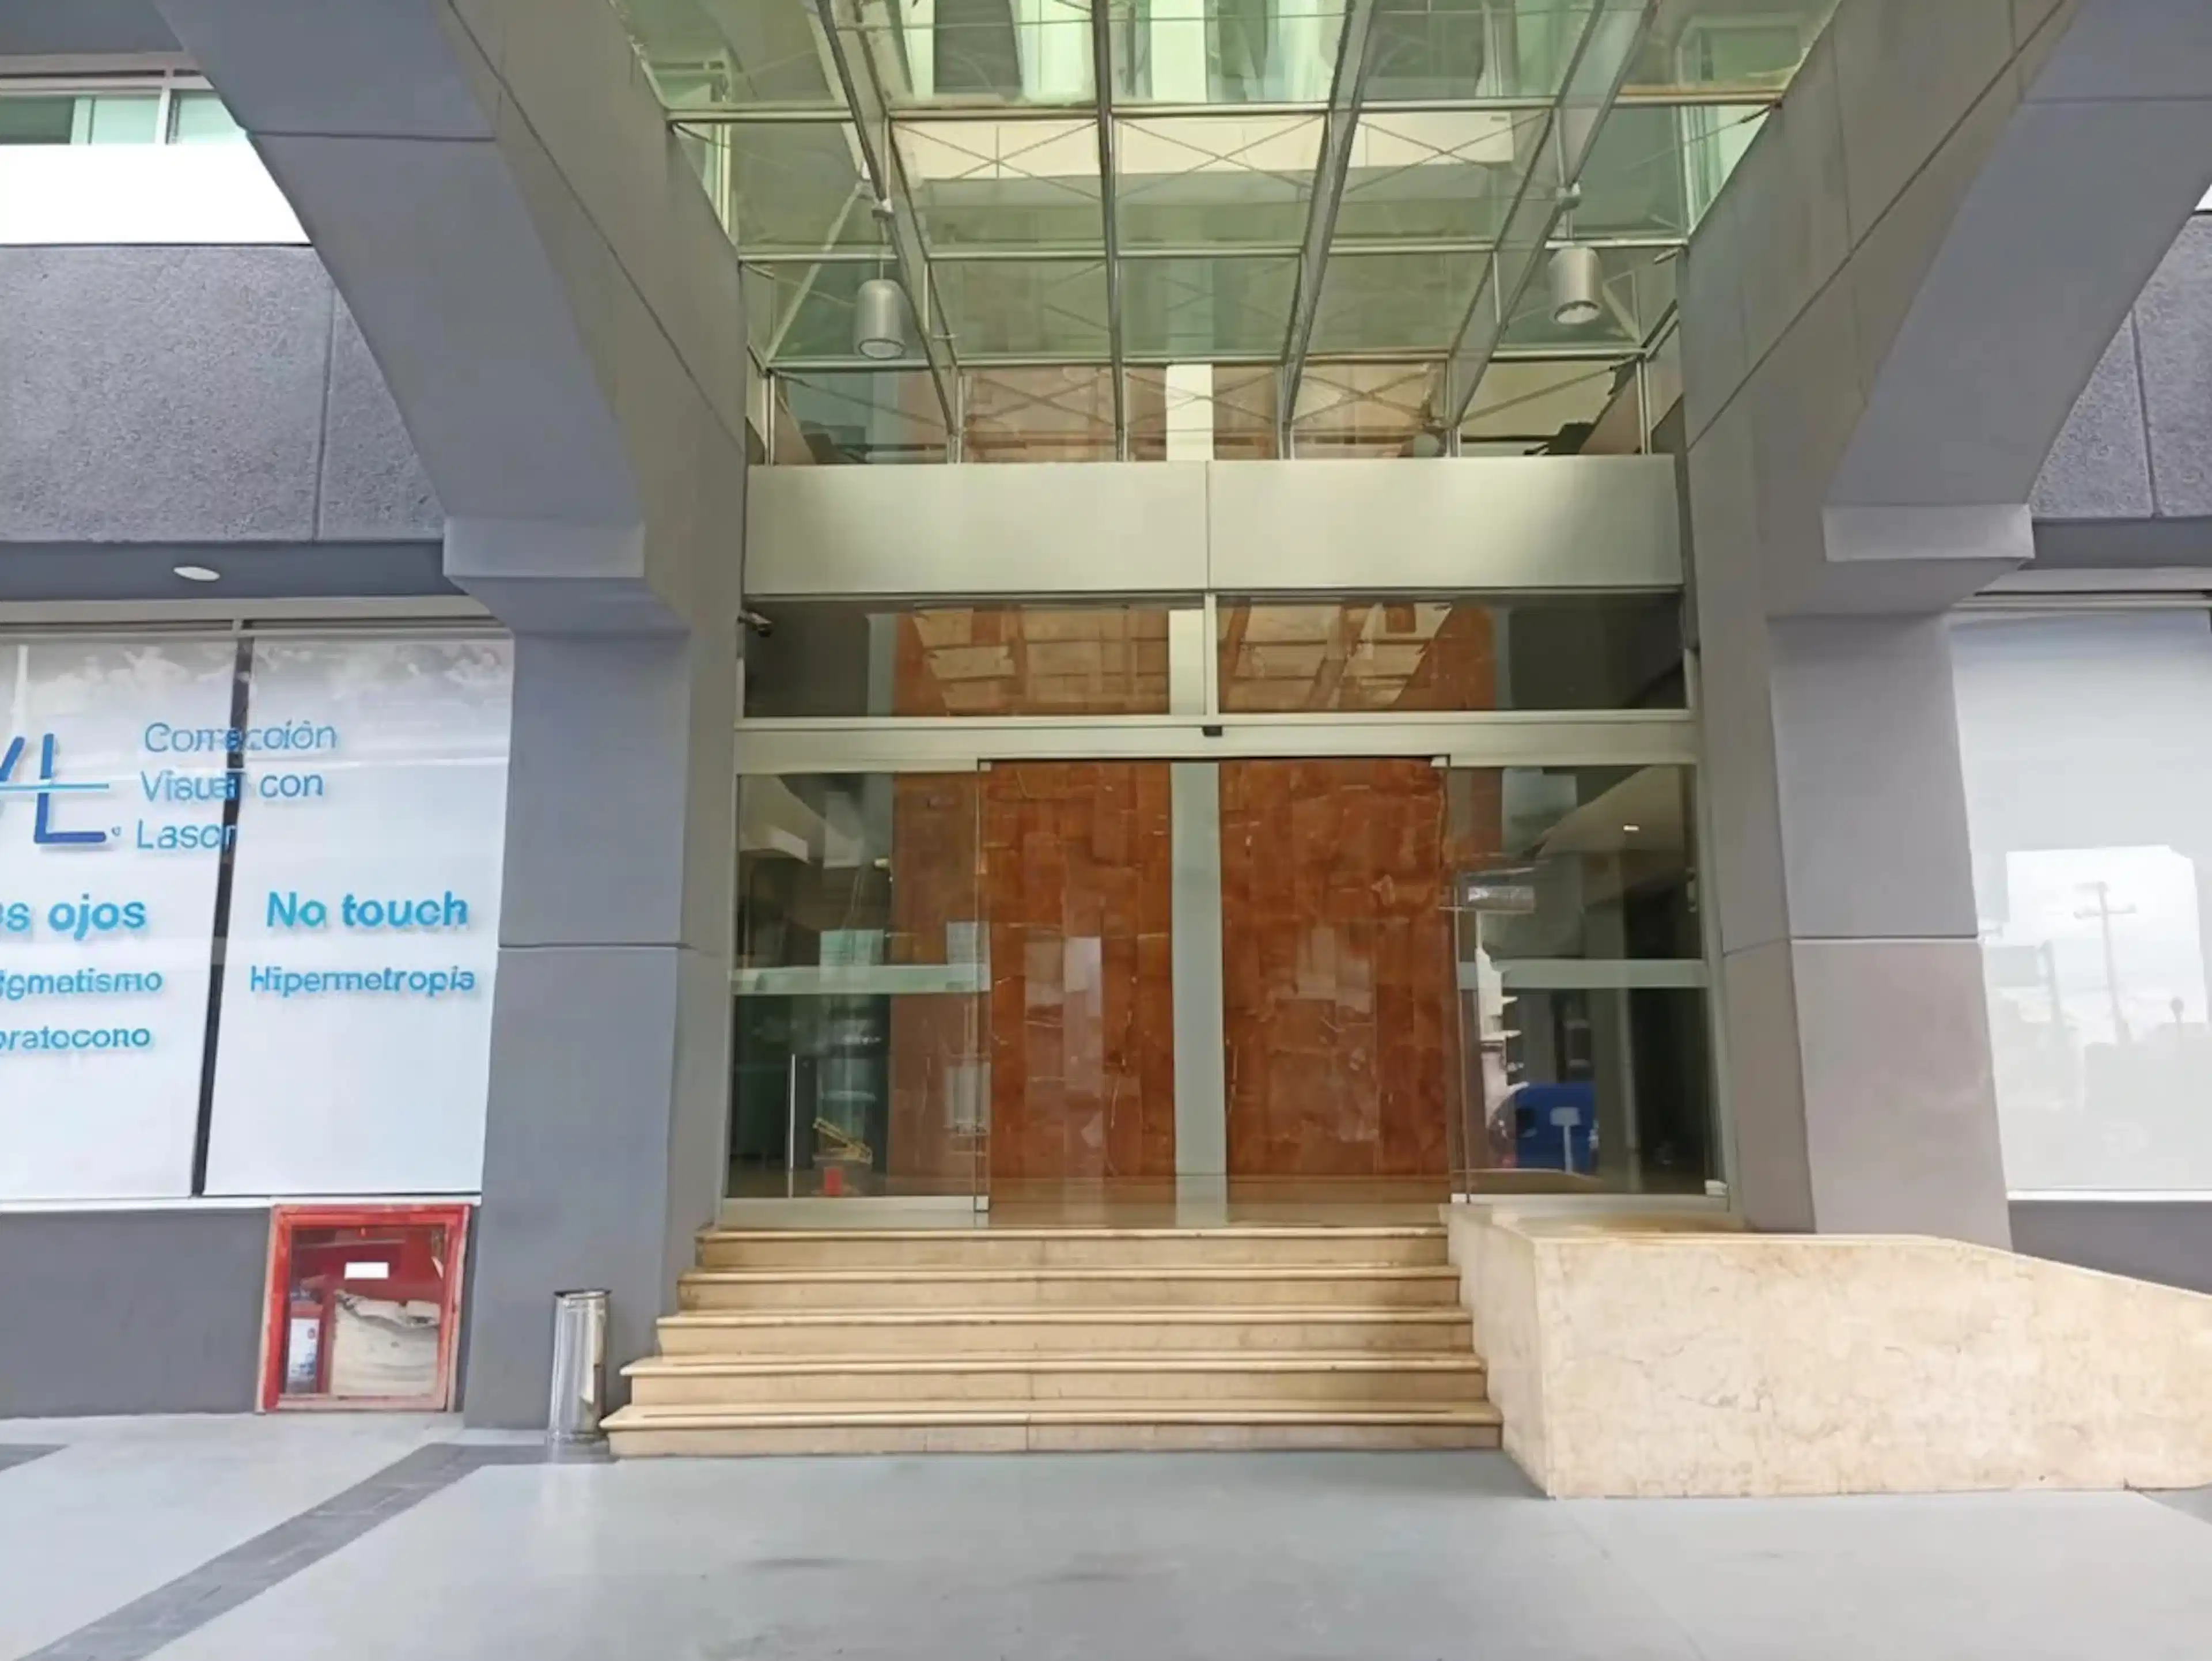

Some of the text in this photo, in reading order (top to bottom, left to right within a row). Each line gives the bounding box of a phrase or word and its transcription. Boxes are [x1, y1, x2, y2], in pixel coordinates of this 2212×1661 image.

[259, 774, 324, 799] con
[0, 892, 147, 941] s ojos
[266, 890, 469, 928] No touch
[250, 964, 475, 998] Hipermetropia
